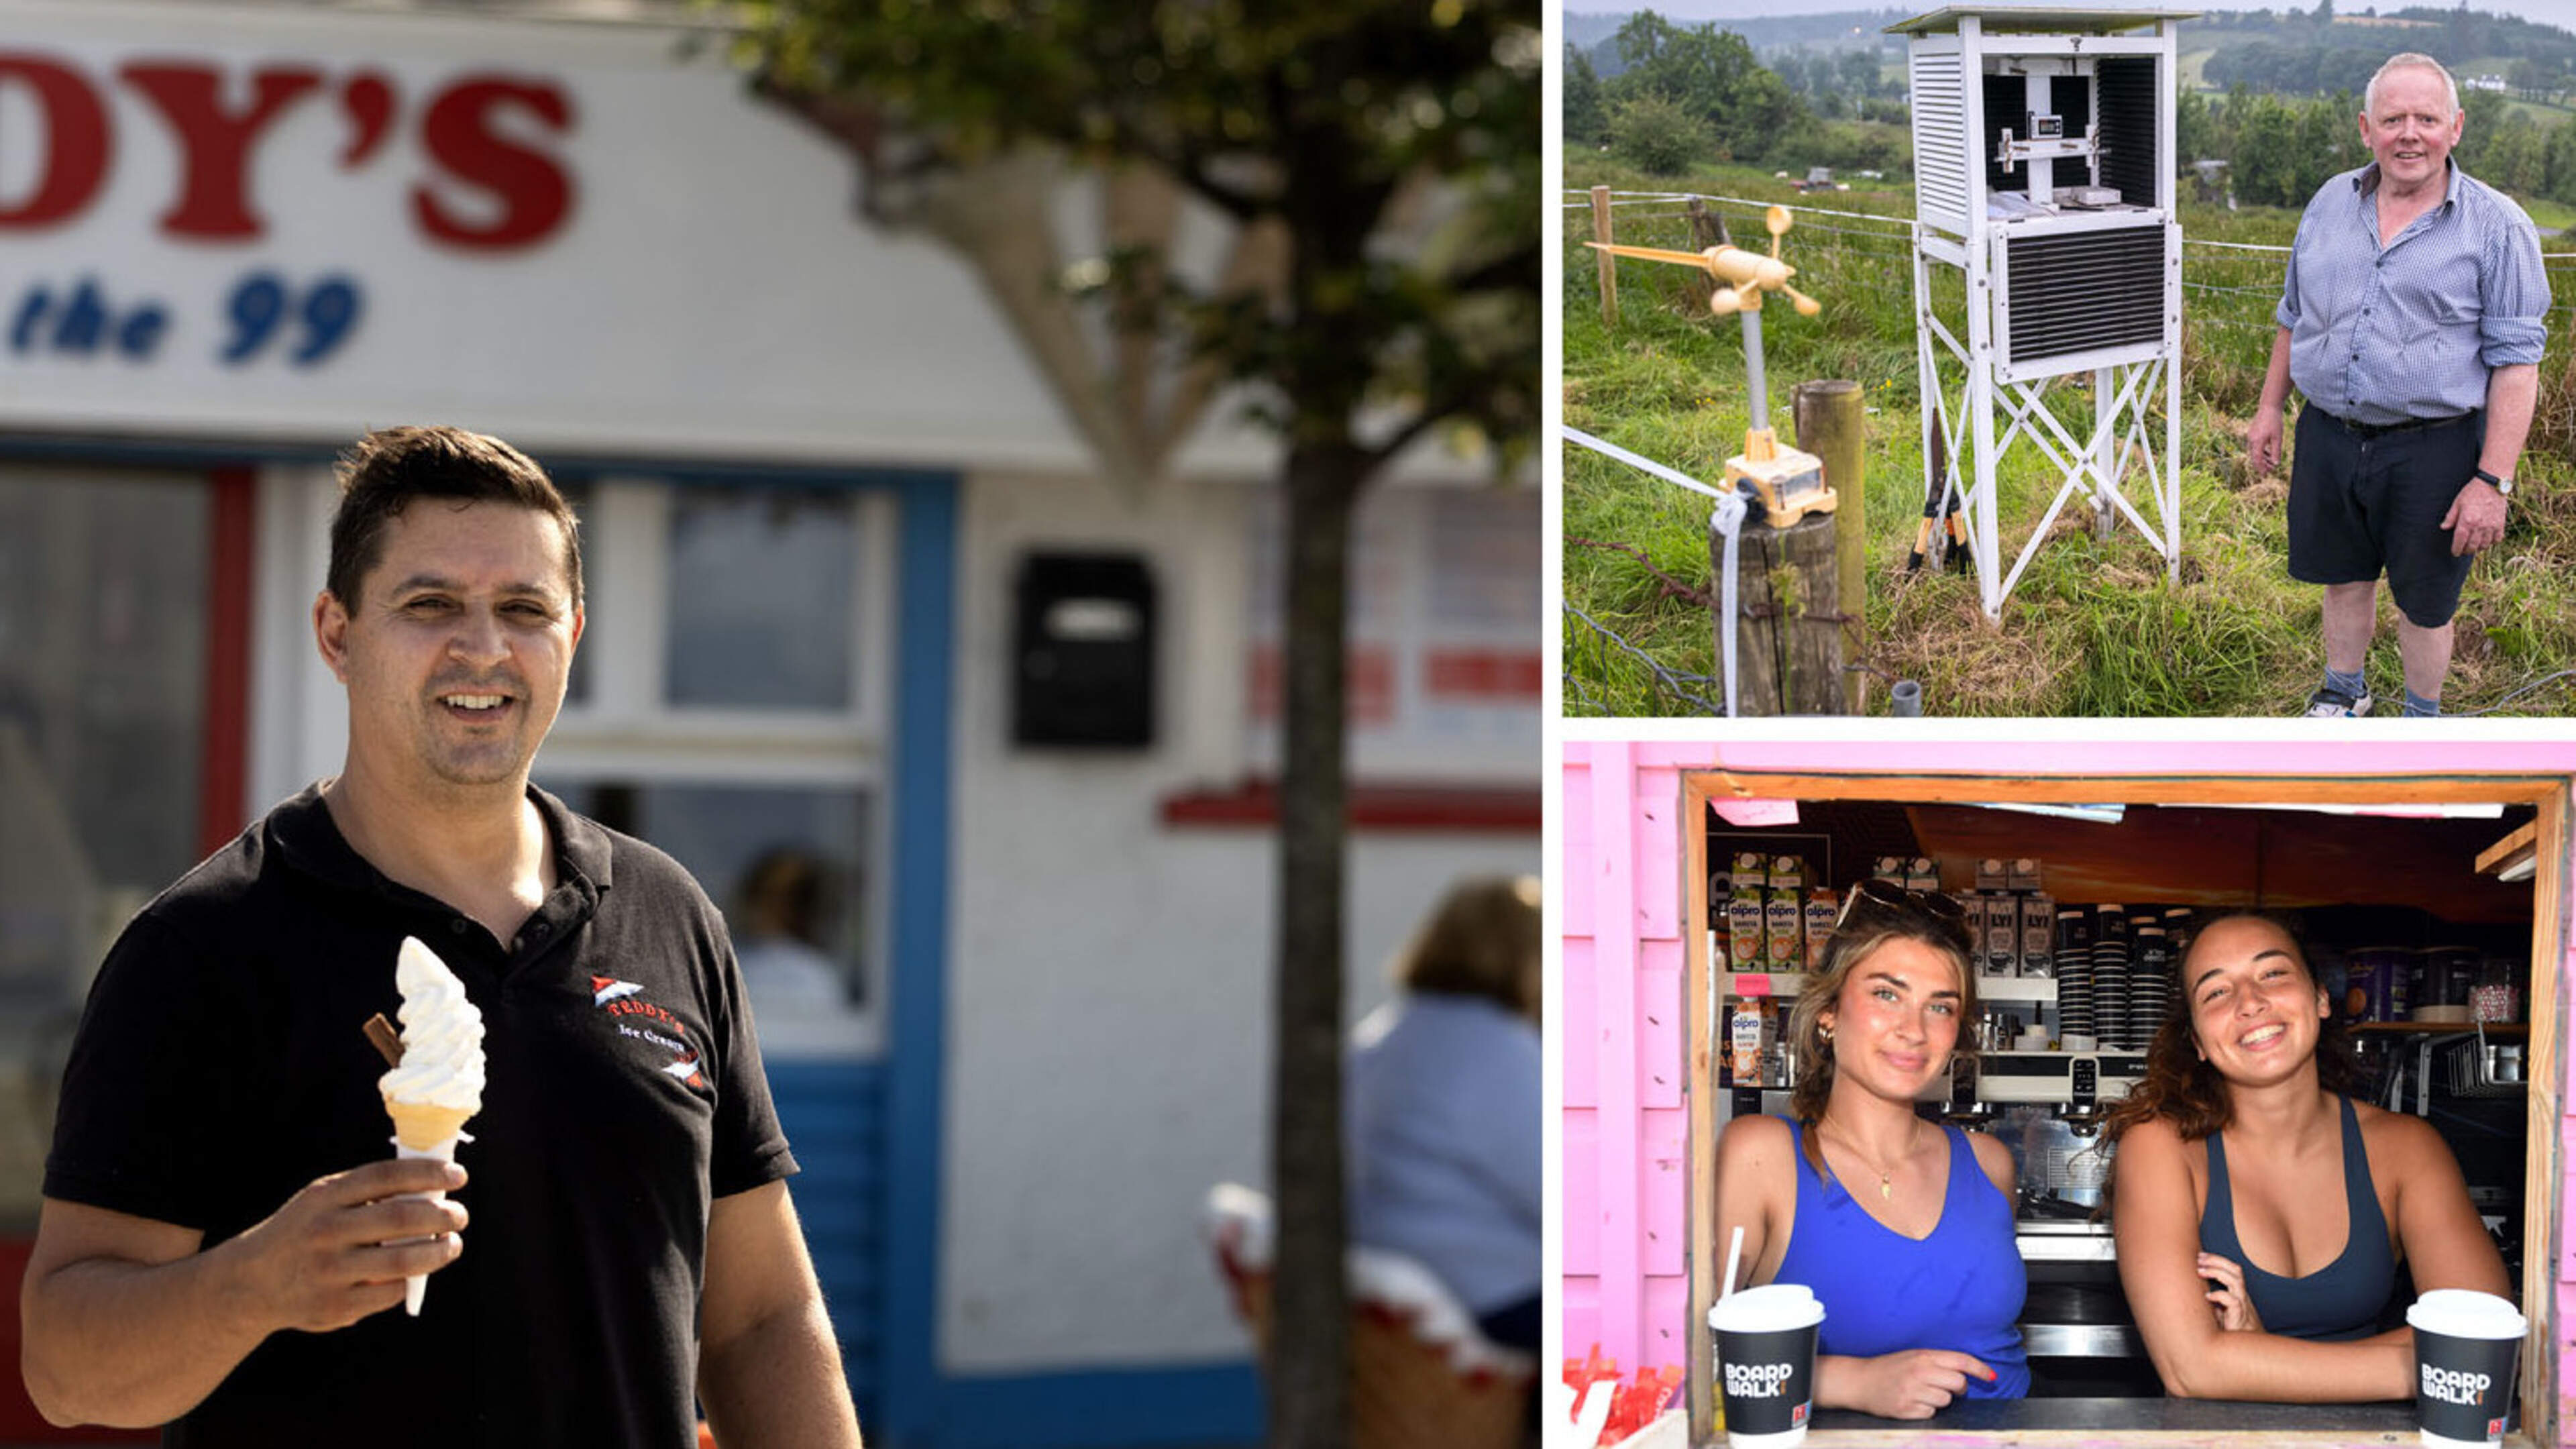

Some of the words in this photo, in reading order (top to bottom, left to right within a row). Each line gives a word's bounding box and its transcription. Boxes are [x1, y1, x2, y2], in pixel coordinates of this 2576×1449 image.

[9, 274, 172, 363] the
[216, 270, 366, 368] 99
[1731, 904, 1760, 918] alpro
[1768, 904, 1796, 918] alpro
[1807, 905, 1836, 919] alpro
[1733, 1017, 1758, 1030] alpro
[1725, 1362, 1792, 1382] BOARD
[2422, 1363, 2491, 1391] BOARD
[1726, 1379, 1780, 1398] WALK
[2422, 1379, 2476, 1405] WALK
